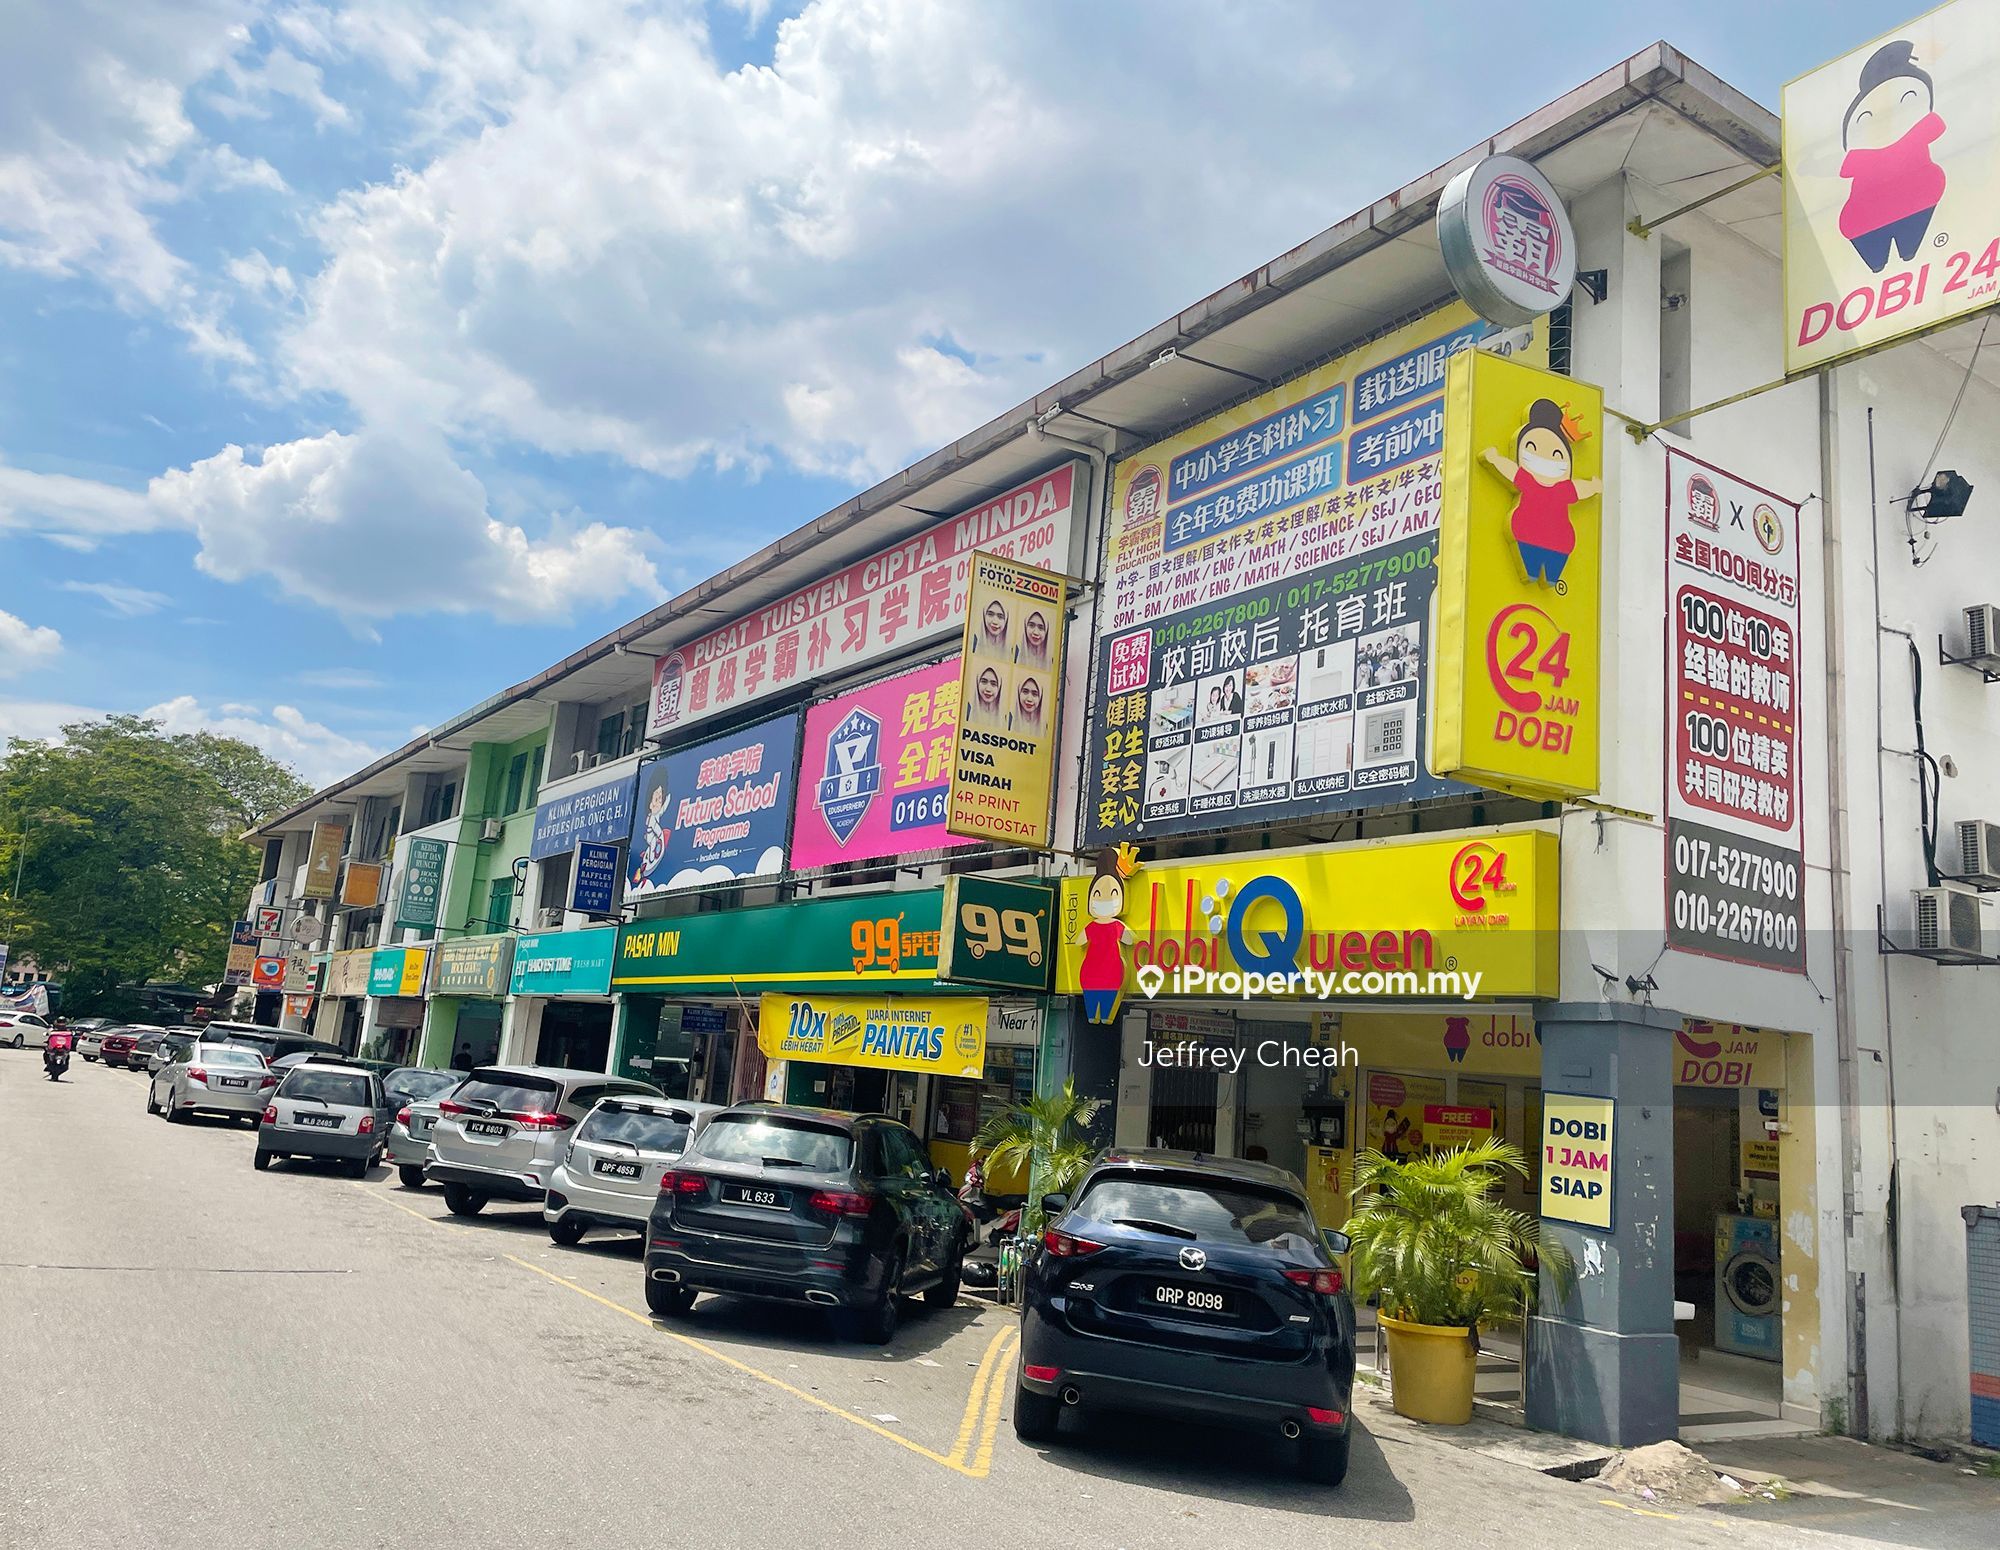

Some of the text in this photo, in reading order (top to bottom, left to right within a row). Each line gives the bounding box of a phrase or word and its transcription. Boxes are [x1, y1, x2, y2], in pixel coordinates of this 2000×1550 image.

[1798, 238, 2000, 347] DOBI 24
[1967, 280, 1997, 300] JAM
[1175, 394, 1339, 490] 中小学全科补习
[1170, 451, 1334, 545] 全年免费功课班
[1729, 501, 1745, 531] X
[1019, 523, 1054, 556] 7800
[1118, 521, 1163, 551] 学霸教育
[1115, 551, 1161, 574] EDUCATION
[1117, 539, 1161, 564] FLY HIGH
[1117, 590, 1135, 610] PT3
[1146, 581, 1163, 600] BM
[1175, 567, 1200, 589] BMK
[1213, 556, 1235, 573] ENG
[1249, 538, 1286, 563] MATH
[1301, 513, 1355, 546] SCIENCE
[1372, 497, 1396, 522] SEJ
[693, 480, 1058, 667] PUSAT TUISYEN CIPTA MINDA
[979, 566, 1059, 599] FOTO-ZZOOM
[1113, 510, 1429, 629] SPM BM BMK ENG MATH SCIENCE SEJ AM
[1675, 532, 1796, 604] 全国100间分行
[1155, 546, 1431, 647] 010-2267800 017-5277900
[688, 565, 952, 712] 超级学霸补习学院
[1160, 581, 1408, 689] 校前校后 托育班
[1683, 595, 1791, 663] 100位10年
[1114, 635, 1147, 666] 免费
[1505, 622, 1571, 688] 24
[1112, 662, 1145, 689] 试补
[1683, 639, 1791, 714] 经验的教师
[899, 679, 961, 738] 免费
[1106, 691, 1147, 729] 健康
[1301, 698, 1348, 719] 健康饮水机
[1365, 686, 1407, 706] 益智活动
[1544, 695, 1580, 716] JAM
[1246, 711, 1290, 730] 营养妈妈餐
[1494, 710, 1573, 755] DOBI
[961, 728, 1036, 756] PASSPORT
[1103, 725, 1144, 762] 卫生
[1685, 710, 1789, 779] 100位精英
[697, 743, 765, 789] 英雄学院
[960, 749, 995, 767] VISA
[958, 769, 1012, 791] UMRAH
[1101, 759, 1142, 797] 安全
[1297, 776, 1345, 794] 私人收纳柜
[1357, 767, 1410, 785] 安全密码锁
[1685, 758, 1789, 823] 共同研发教材
[548, 786, 620, 822] KLINIK PERGIGIAN
[675, 771, 782, 830] Future School
[828, 800, 866, 815] EDUSUPERHERO
[955, 789, 1020, 814] 4R PRINT
[1193, 793, 1232, 809] 午睡休息区
[1243, 784, 1286, 803] 洗澡热水器
[588, 809, 605, 827] ONG
[895, 796, 928, 825] 016
[954, 810, 1037, 838] PHOTOSTAT
[1098, 795, 1140, 830] 安心
[1149, 802, 1180, 817] 安全系统
[692, 820, 750, 850] Programme
[581, 858, 614, 870] PERGIGIAN
[588, 849, 609, 859] KLINIK
[1675, 834, 1797, 901] 017-5277900
[580, 870, 612, 881] RAFFLES
[1460, 852, 1508, 892] 24
[262, 911, 278, 931] 7
[1064, 892, 1079, 945] Kedai
[1455, 913, 1509, 928] LAYAN DIRI
[1674, 889, 1797, 953] 010-2267800
[624, 930, 681, 958] PASAR MINI
[851, 918, 900, 974] 99
[961, 903, 1042, 967] 99
[788, 1001, 826, 1041] 10x
[866, 1009, 932, 1023] JUARA INTERNET
[962, 1023, 973, 1036] #1
[1000, 1013, 1028, 1030] Near
[860, 1024, 944, 1061] PANTAS
[1482, 1015, 1530, 1048] dobi
[780, 1040, 824, 1053] LEBIH HEBAT!
[1724, 1040, 1758, 1055] JAM
[1680, 1060, 1753, 1086] DOBI
[1441, 1112, 1472, 1123] FREE
[1550, 1117, 1607, 1142] DOBI
[601, 1162, 616, 1172] BPF
[1546, 1145, 1608, 1172] 1 JAM
[741, 1188, 775, 1204] VL 633
[1550, 1176, 1602, 1200] SIAP
[1156, 1286, 1223, 1310] QRP 8098
